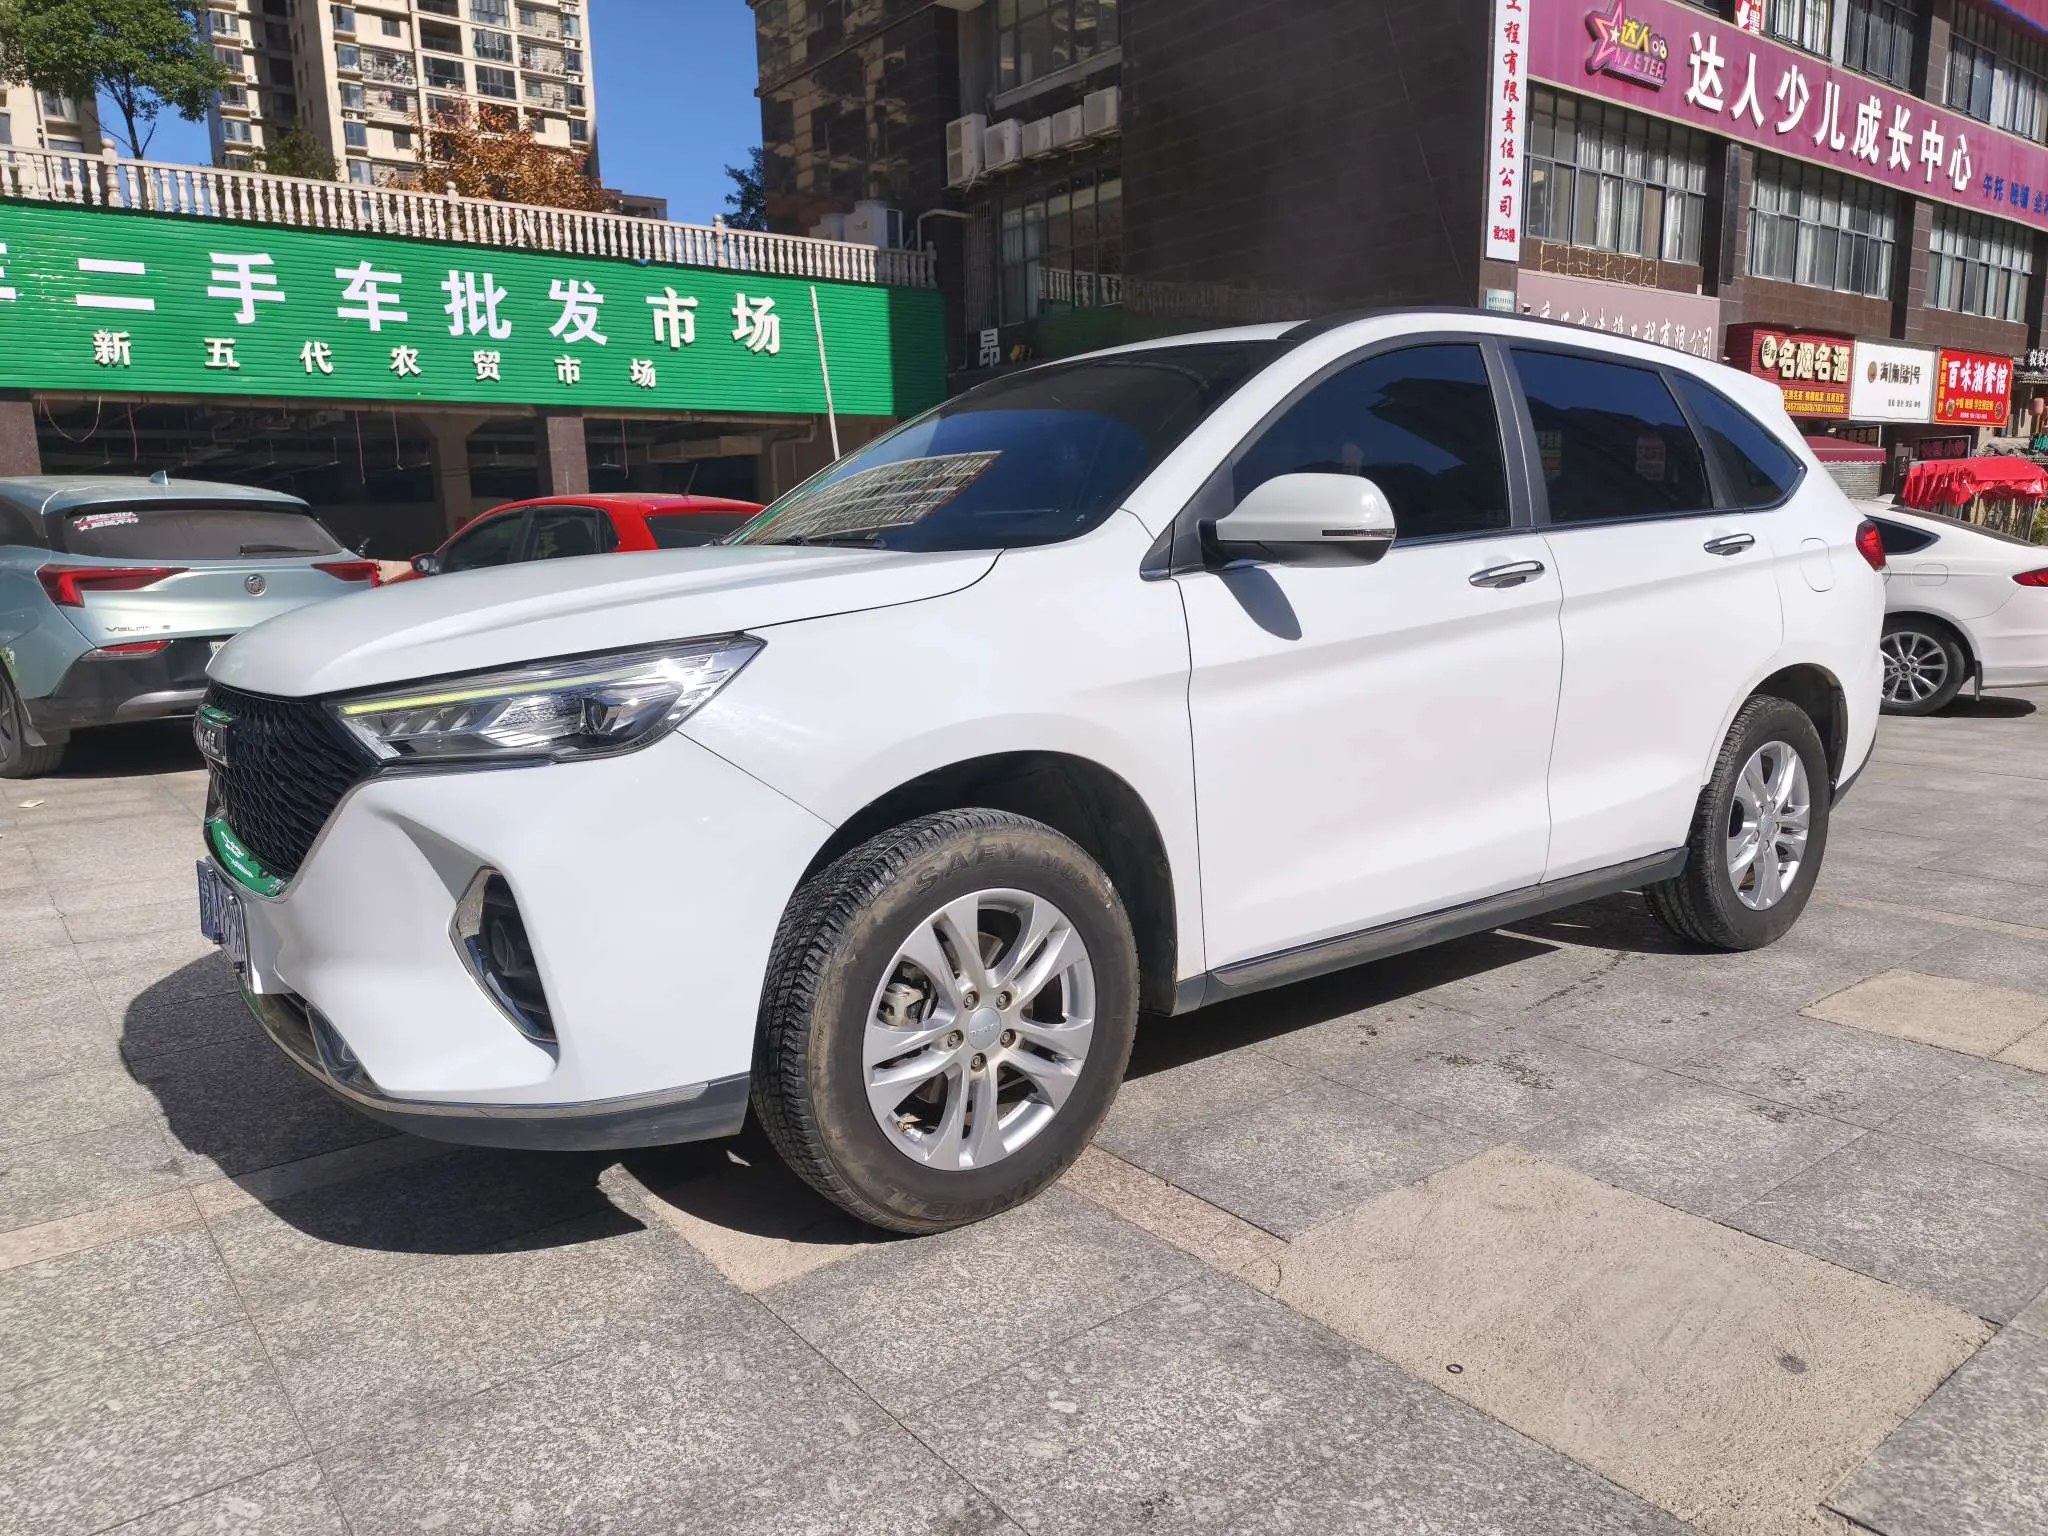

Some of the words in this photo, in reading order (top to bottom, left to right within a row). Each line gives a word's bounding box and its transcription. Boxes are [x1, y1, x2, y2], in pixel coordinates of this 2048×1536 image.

[1621, 18, 1650, 55] 达人
[1684, 31, 1972, 192] 达人少儿成长中心
[0, 243, 781, 355] 二手车批发市场
[93, 329, 657, 389] 新五代农贸市场
[1778, 338, 1850, 383] 名烟名酒
[1948, 358, 2008, 395] 百味湘餐馆
